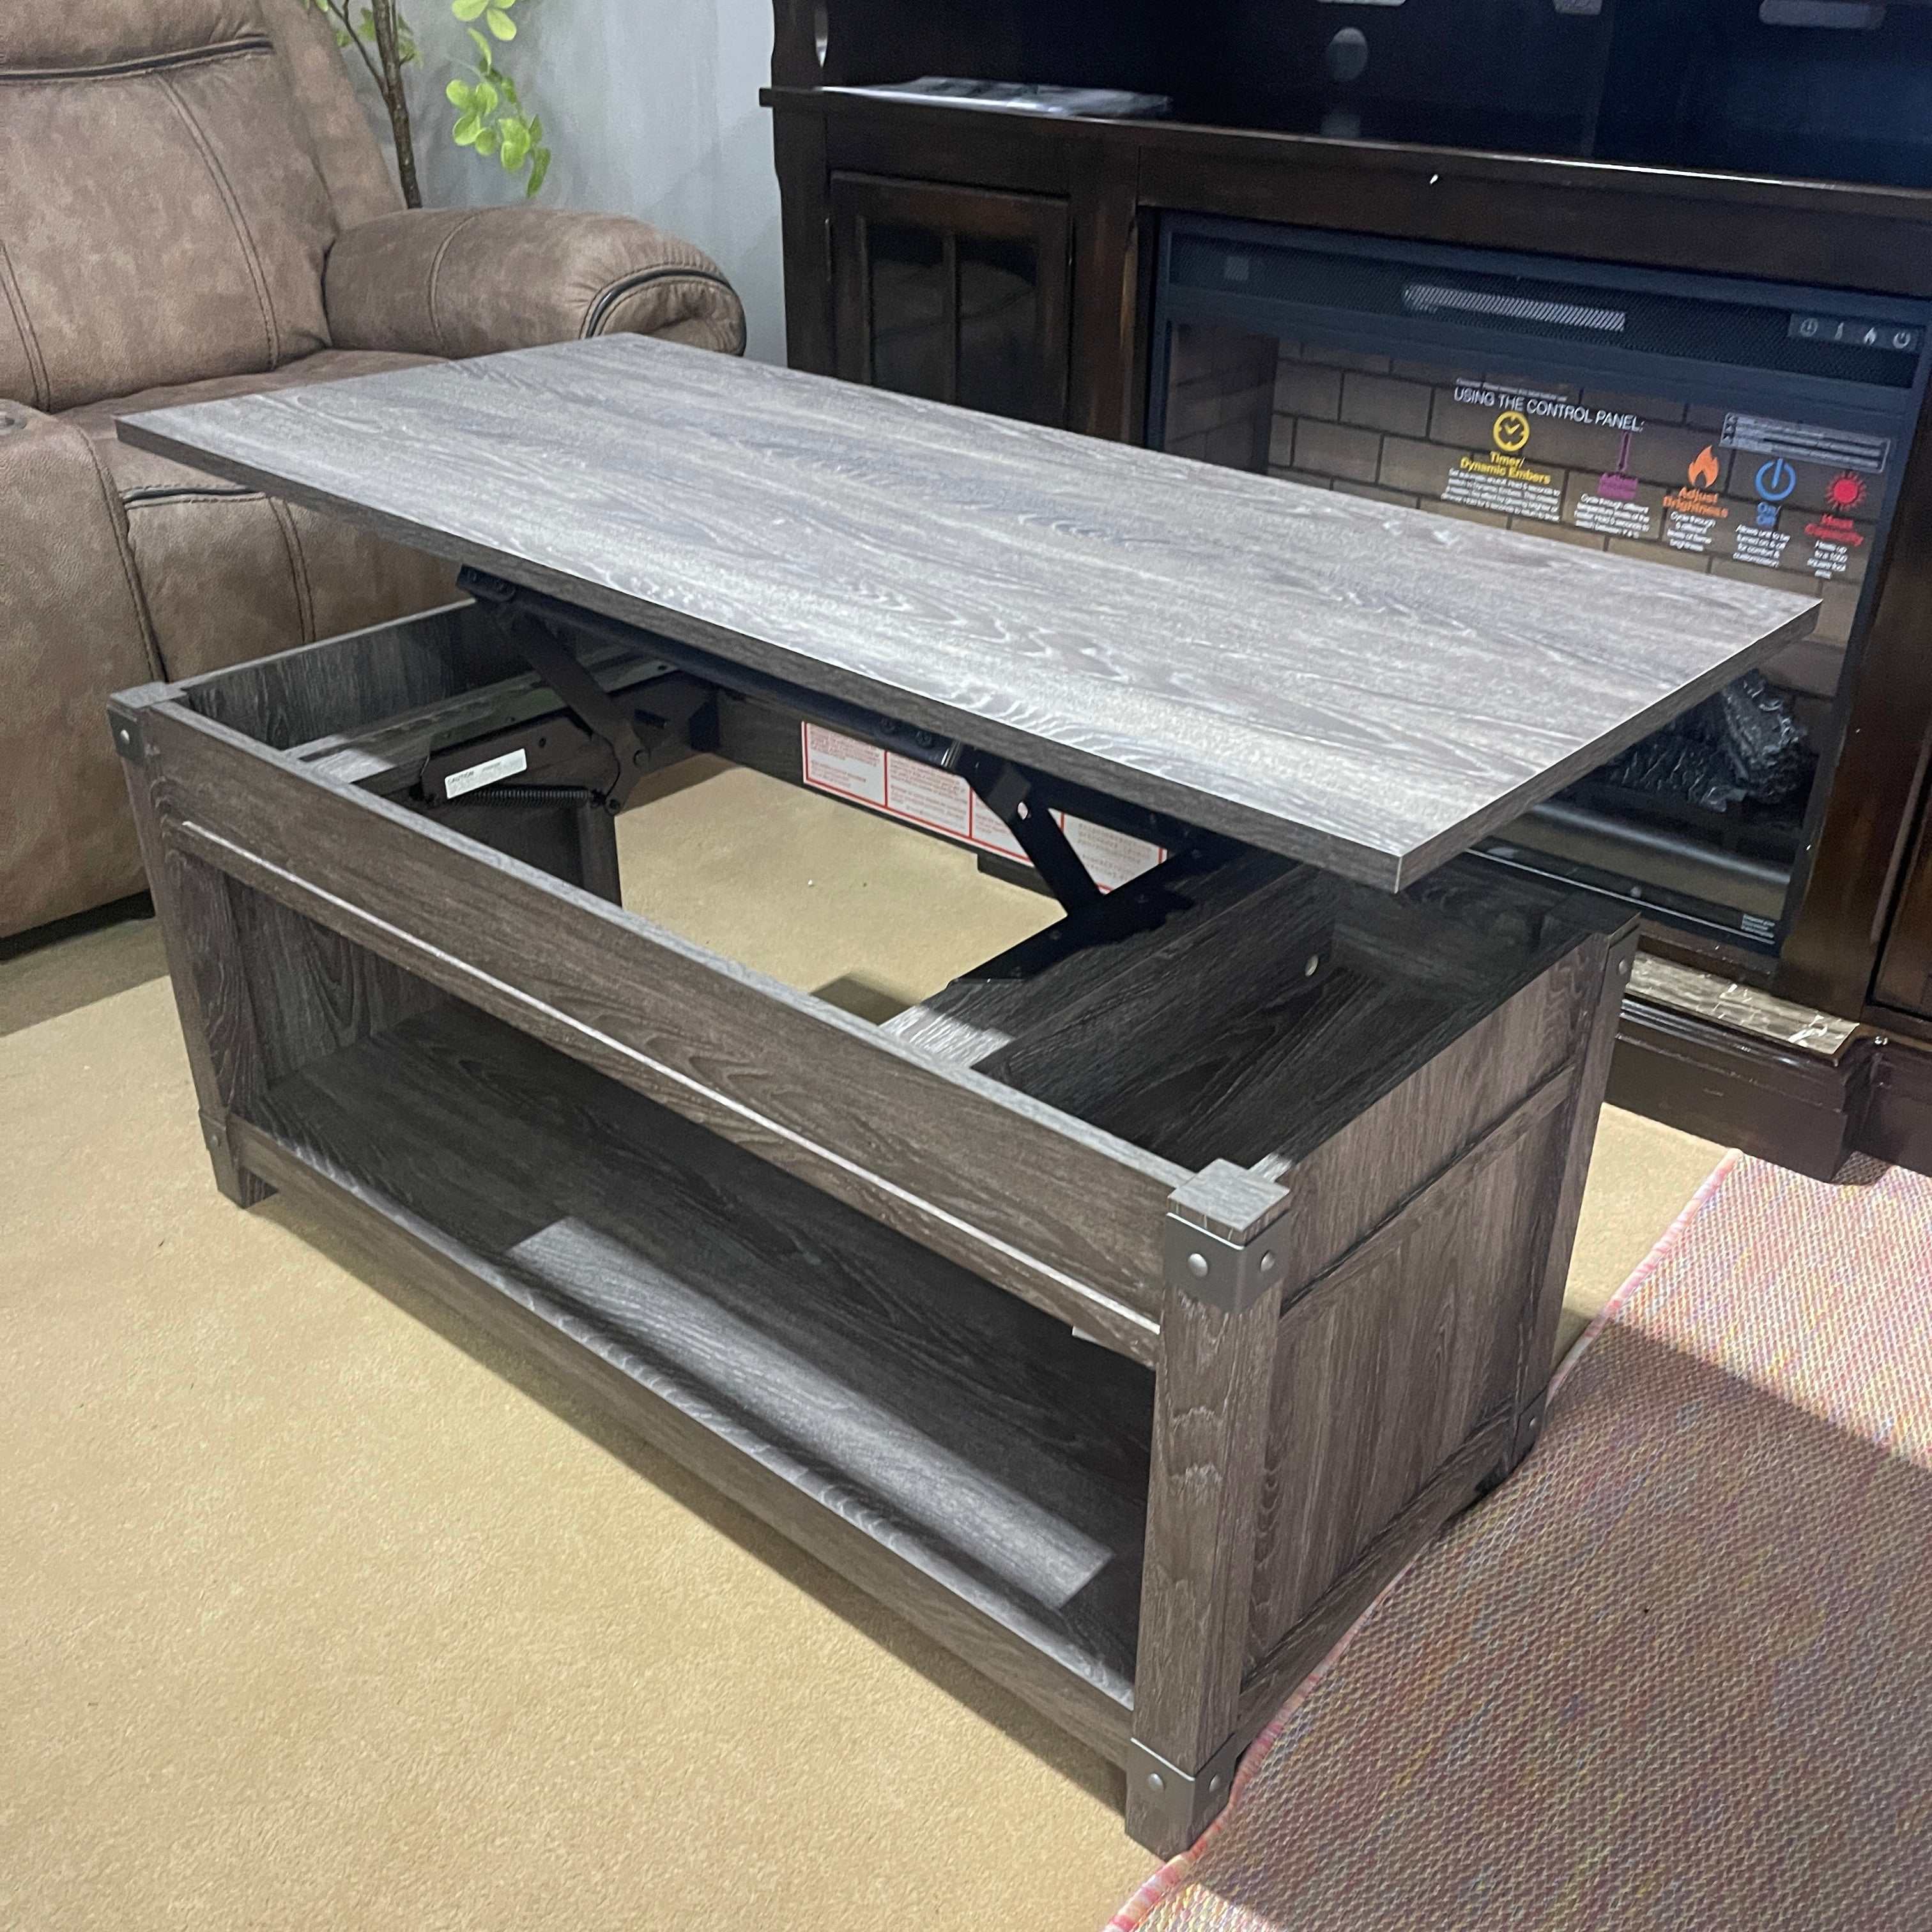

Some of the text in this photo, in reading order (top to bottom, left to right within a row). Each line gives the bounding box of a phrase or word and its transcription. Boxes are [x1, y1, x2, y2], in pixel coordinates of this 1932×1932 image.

[1454, 386, 1495, 407] USING
[1498, 394, 1525, 411] THE
[1526, 399, 1593, 424] CONTROL
[1595, 410, 1645, 432] PANEL:
[1460, 456, 1506, 477] Dynamic
[1508, 466, 1551, 485] Embers
